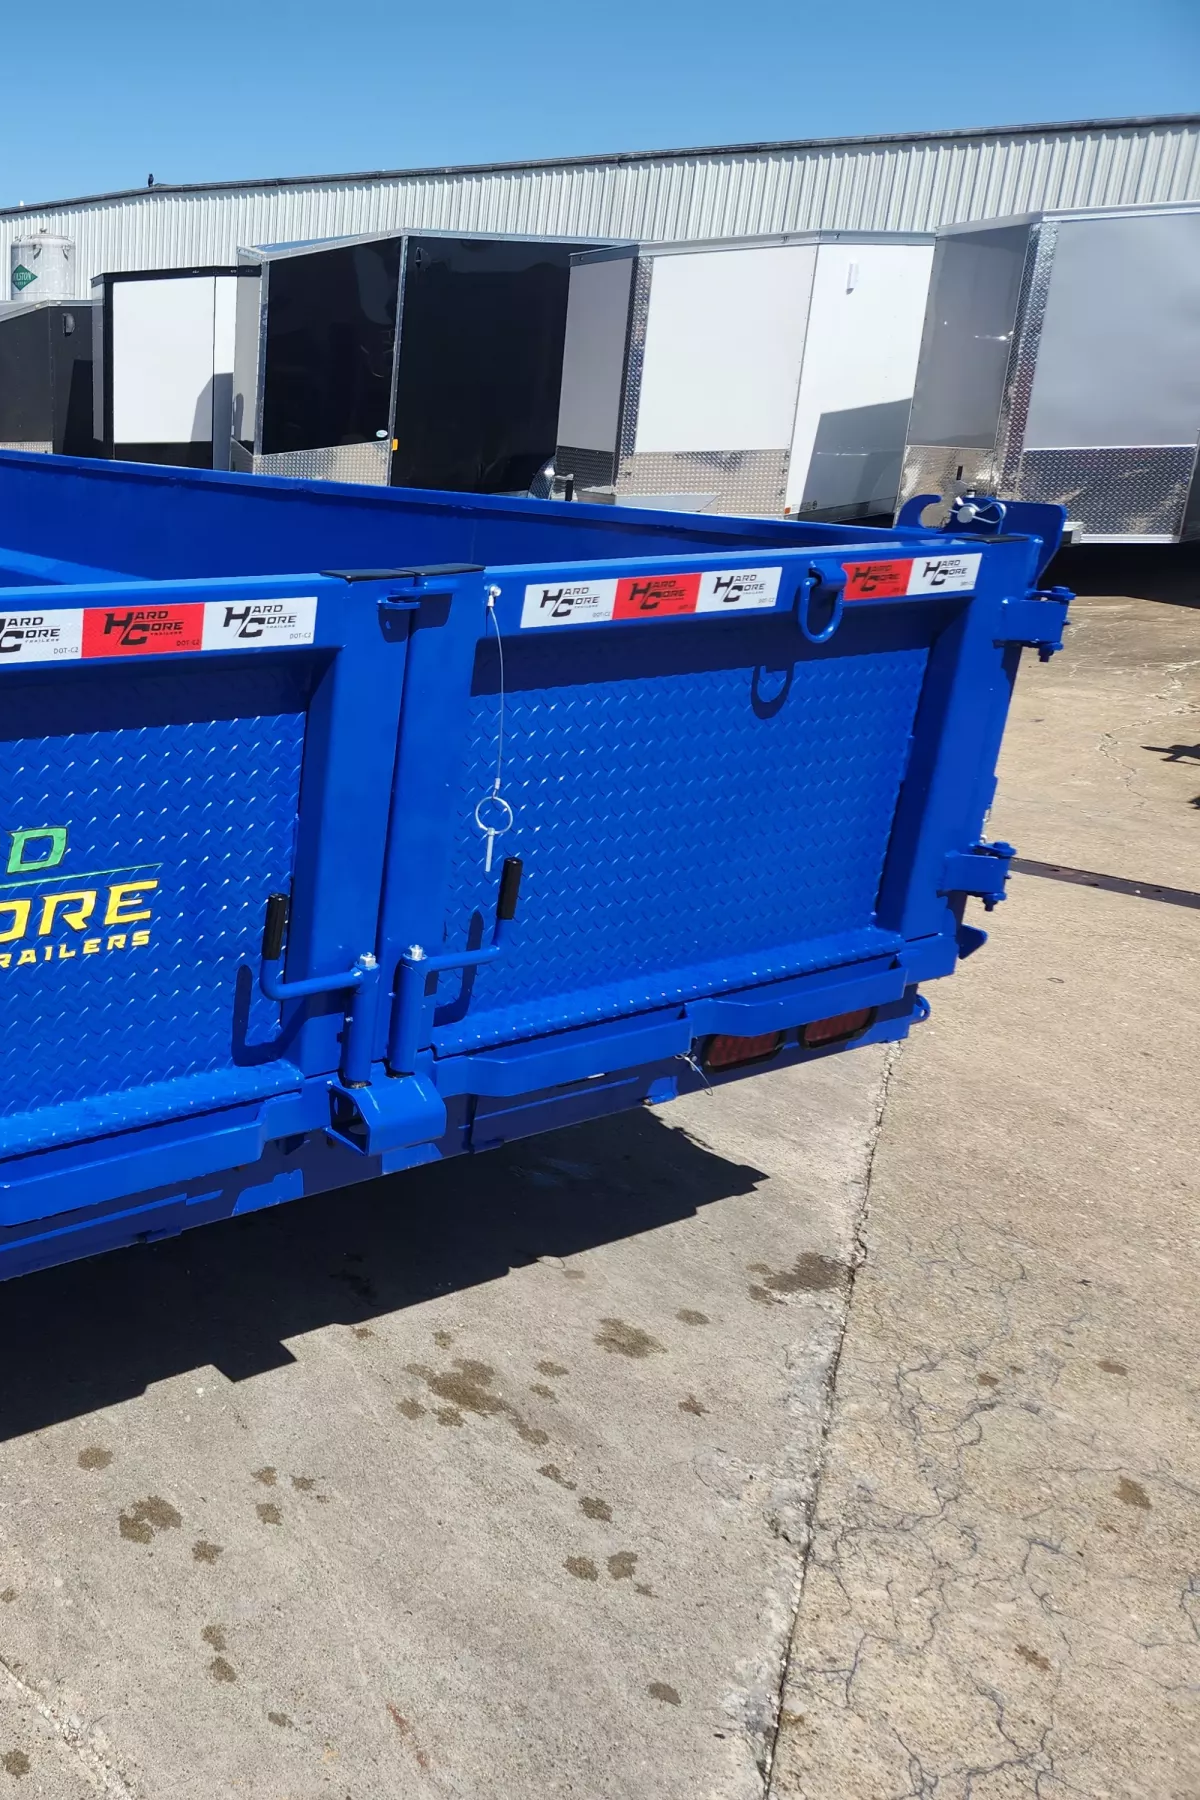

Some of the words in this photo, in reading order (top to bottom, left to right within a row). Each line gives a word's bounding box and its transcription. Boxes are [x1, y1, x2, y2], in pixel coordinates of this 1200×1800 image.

[923, 560, 961, 577] HARD
[713, 575, 757, 594] HARD
[723, 583, 766, 602] CORE
[540, 587, 589, 608] HARD
[551, 596, 600, 617] CORE
[104, 611, 168, 634] HARD
[223, 605, 283, 628] HARD
[238, 616, 297, 638] CORE
[121, 622, 184, 645] CORE
